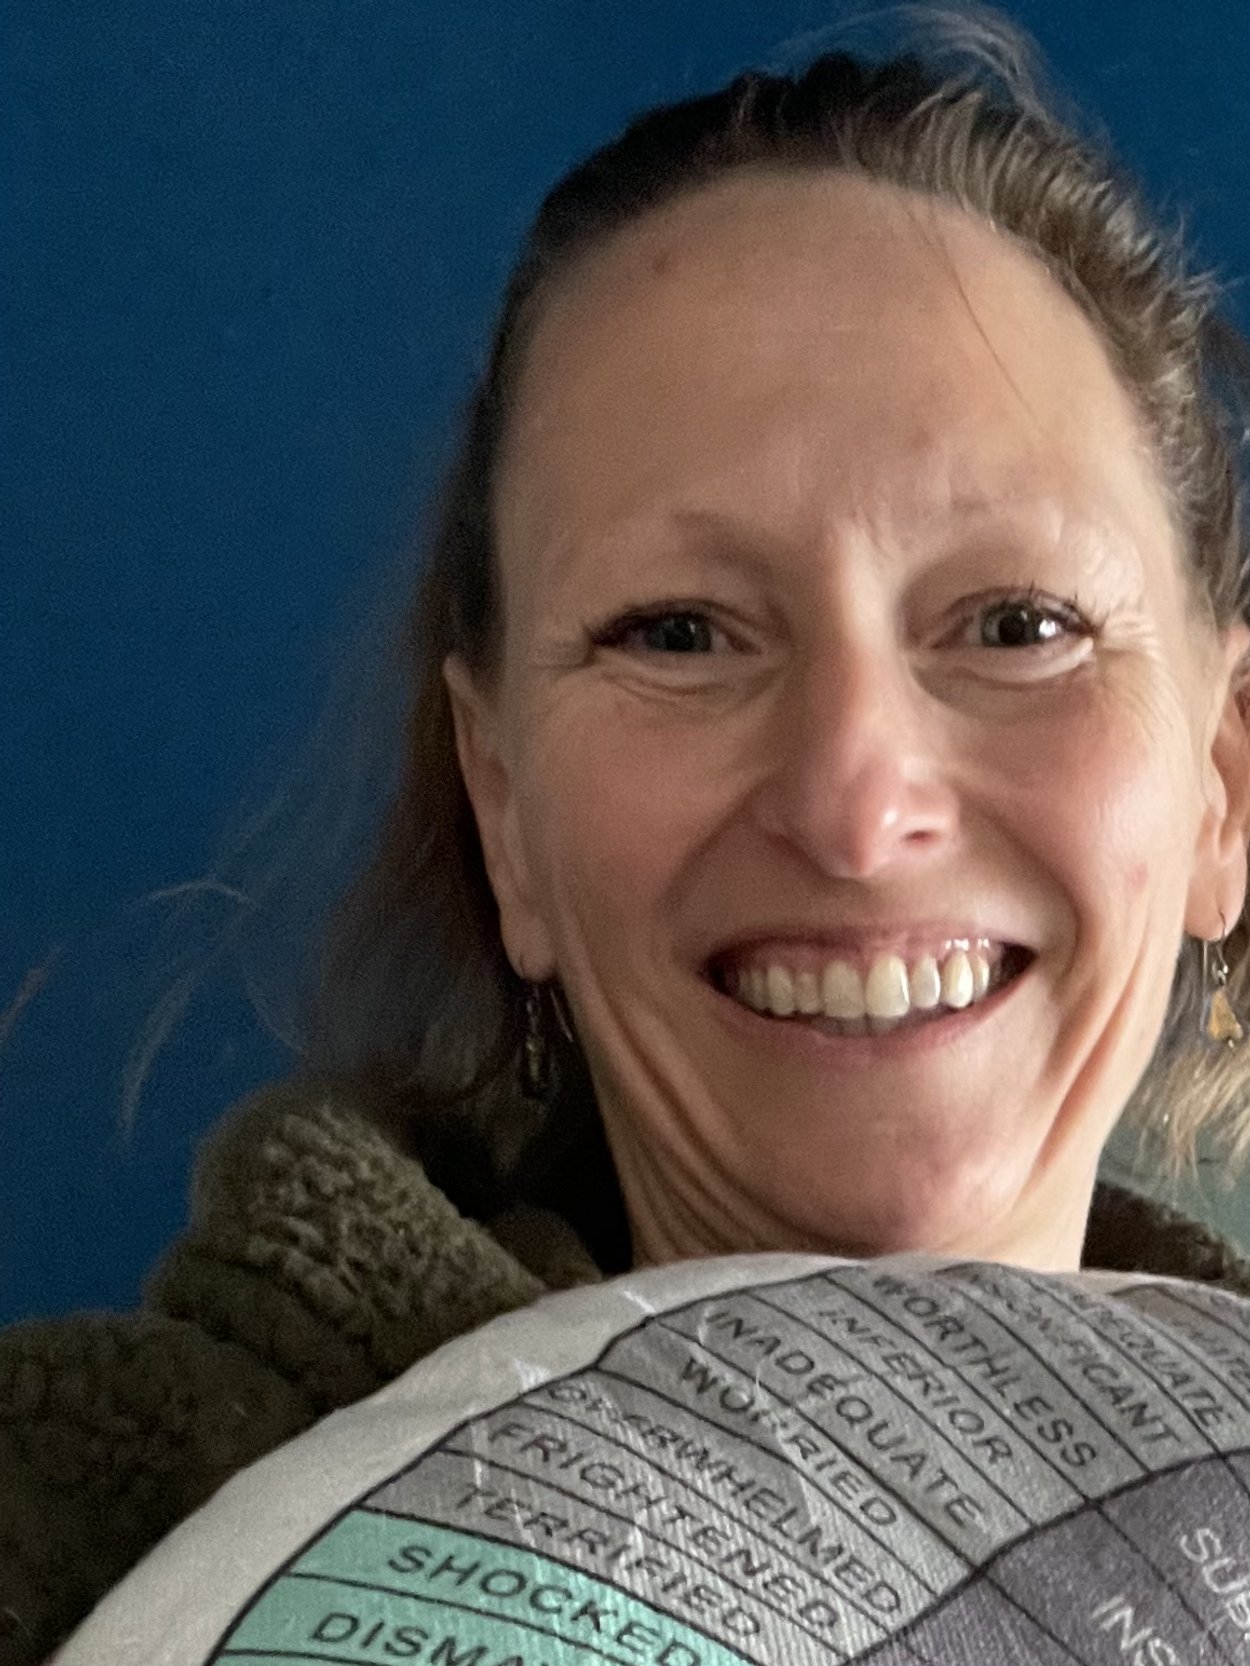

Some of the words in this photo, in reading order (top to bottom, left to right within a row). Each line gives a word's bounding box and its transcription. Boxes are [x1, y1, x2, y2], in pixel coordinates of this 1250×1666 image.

[680, 1356, 898, 1529] WORRIED
[706, 1309, 985, 1528] INADEQUATE
[817, 1307, 1014, 1465] INFERIOR
[490, 1421, 840, 1630] FRIGHTENED
